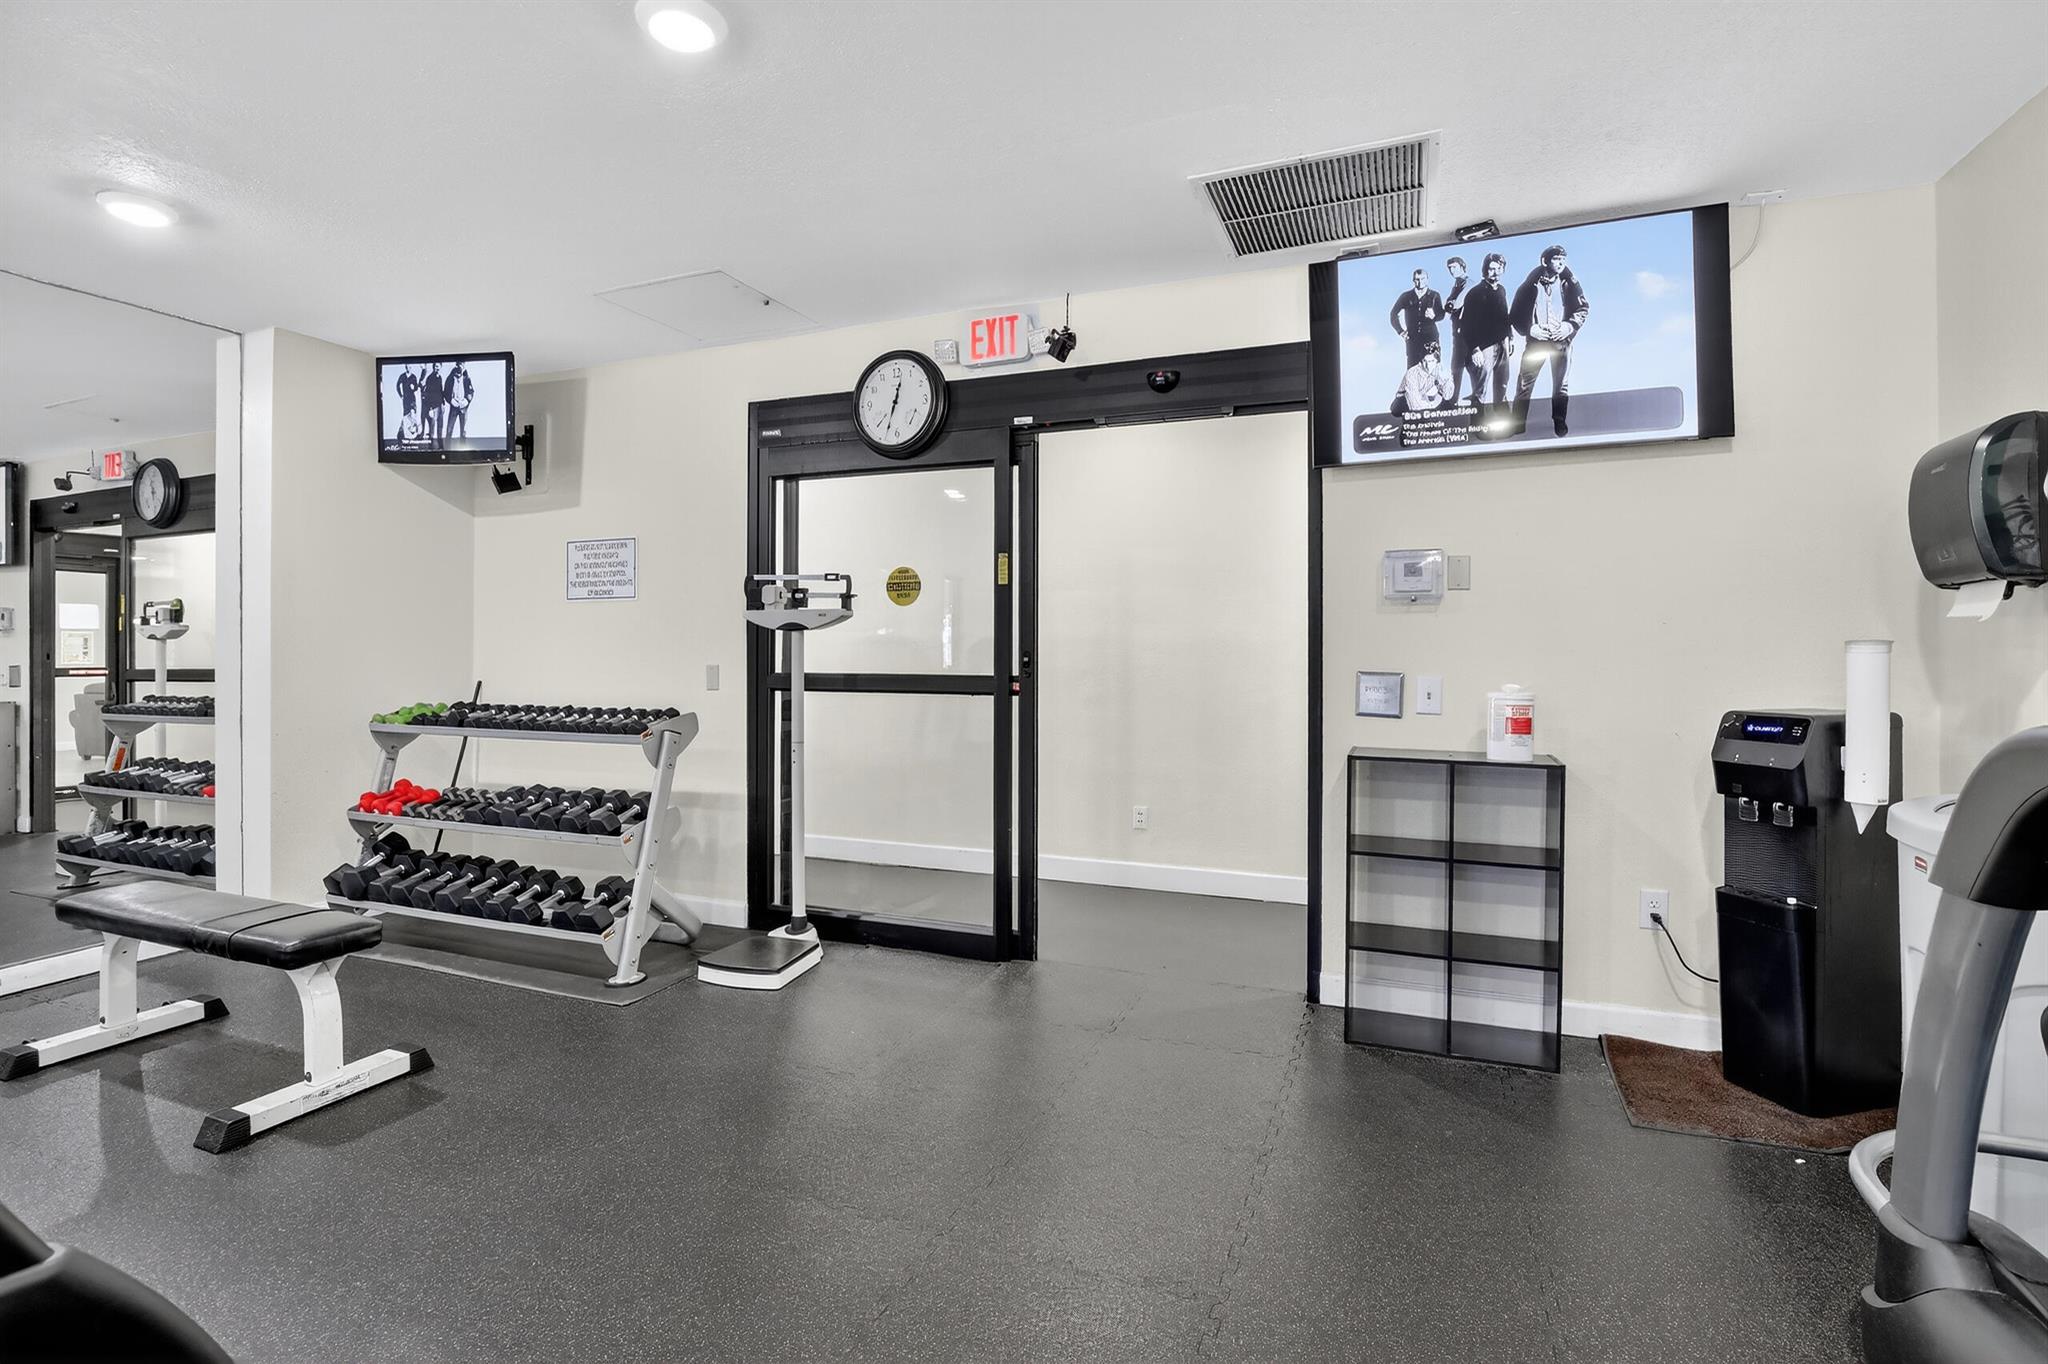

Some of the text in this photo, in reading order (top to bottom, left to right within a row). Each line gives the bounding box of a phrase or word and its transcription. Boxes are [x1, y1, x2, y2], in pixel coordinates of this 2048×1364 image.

[969, 315, 1019, 360] EXIT
[893, 367, 902, 378] 12
[923, 394, 928, 405] 3
[867, 401, 872, 411] 9
[895, 430, 900, 439] 6
